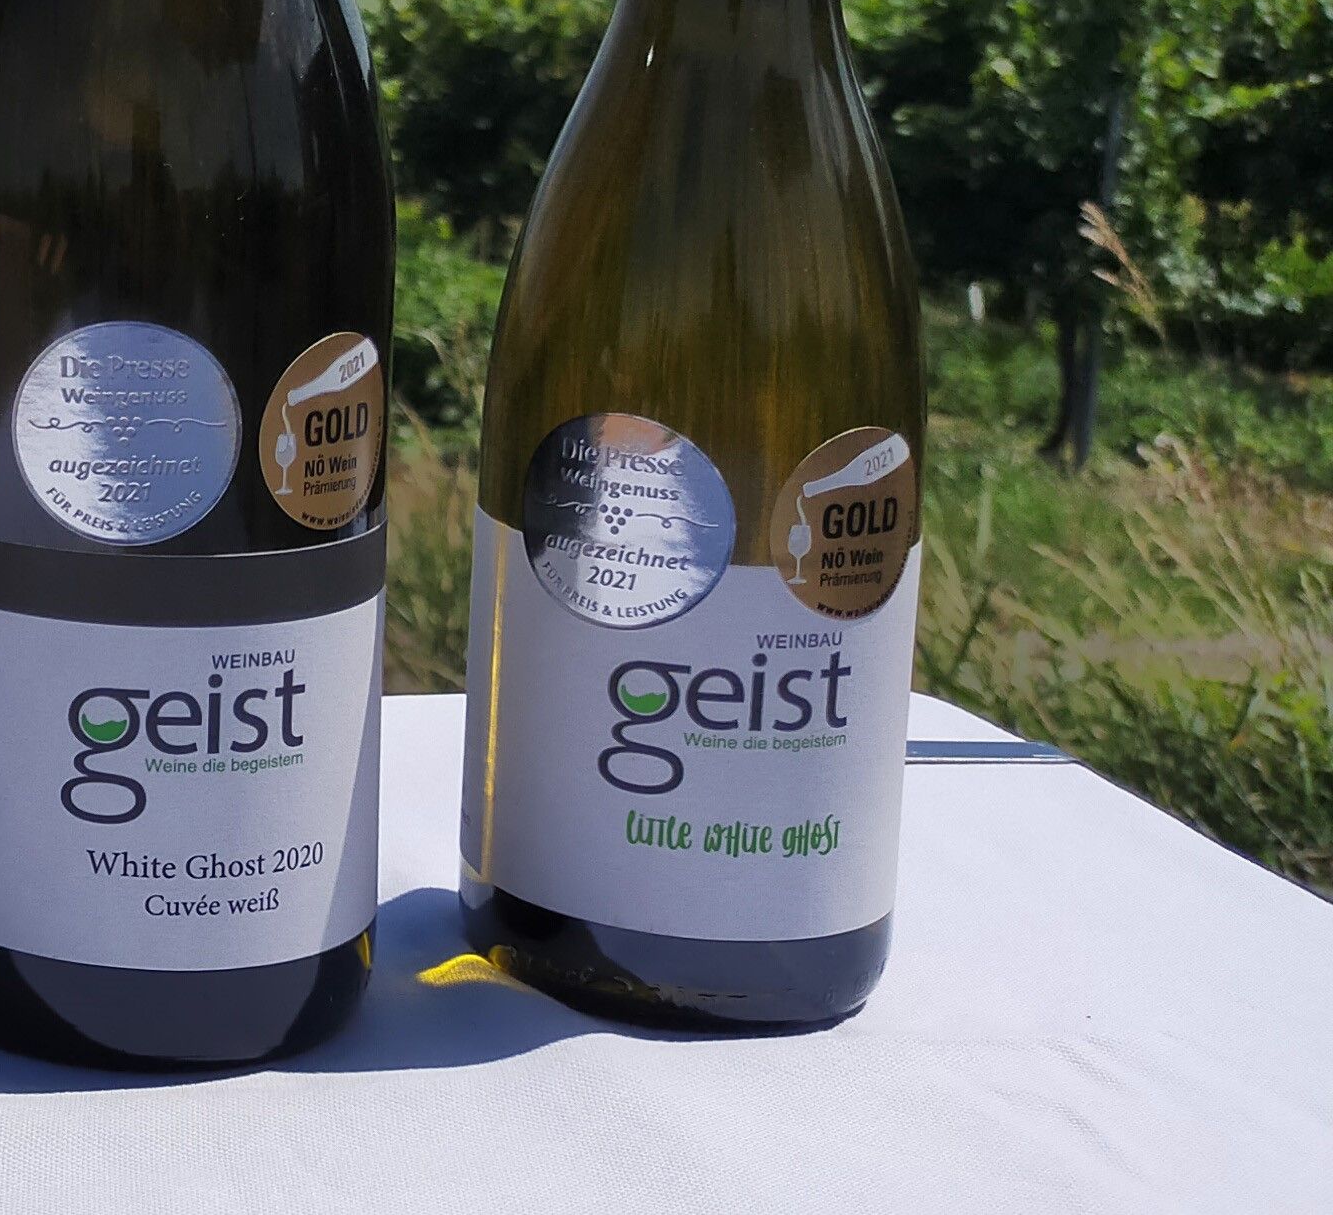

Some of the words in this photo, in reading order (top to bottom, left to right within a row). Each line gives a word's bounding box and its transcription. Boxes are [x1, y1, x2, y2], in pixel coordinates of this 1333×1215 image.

[60, 355, 101, 379] Die
[108, 355, 190, 379] Presse
[338, 351, 366, 384] 2021
[304, 402, 369, 448] GOLD
[304, 454, 326, 479] NÖ
[328, 454, 358, 474] Wein
[561, 436, 600, 464] Die
[604, 446, 683, 477] Presse
[863, 446, 894, 477] 2021
[99, 481, 151, 503] 2021
[822, 496, 898, 540] GOLD
[821, 547, 846, 569] NÖ
[850, 547, 884, 567] Wein
[586, 565, 638, 591] 2021
[617, 587, 688, 618] LEISTUNG
[756, 632, 843, 650] WEINBAU
[211, 648, 296, 670] WEINBAU
[597, 651, 851, 795] geist
[60, 669, 306, 825] geist
[683, 732, 738, 750] Weine
[743, 736, 767, 751] die
[772, 733, 847, 752] begeistern
[145, 758, 197, 773] Weine
[202, 758, 226, 773] die
[231, 752, 304, 774] begeistern
[86, 849, 177, 880] White
[185, 853, 265, 881] Ghost
[272, 841, 324, 873] 2020
[144, 894, 220, 917] Cuvée
[227, 887, 280, 914] weiß
